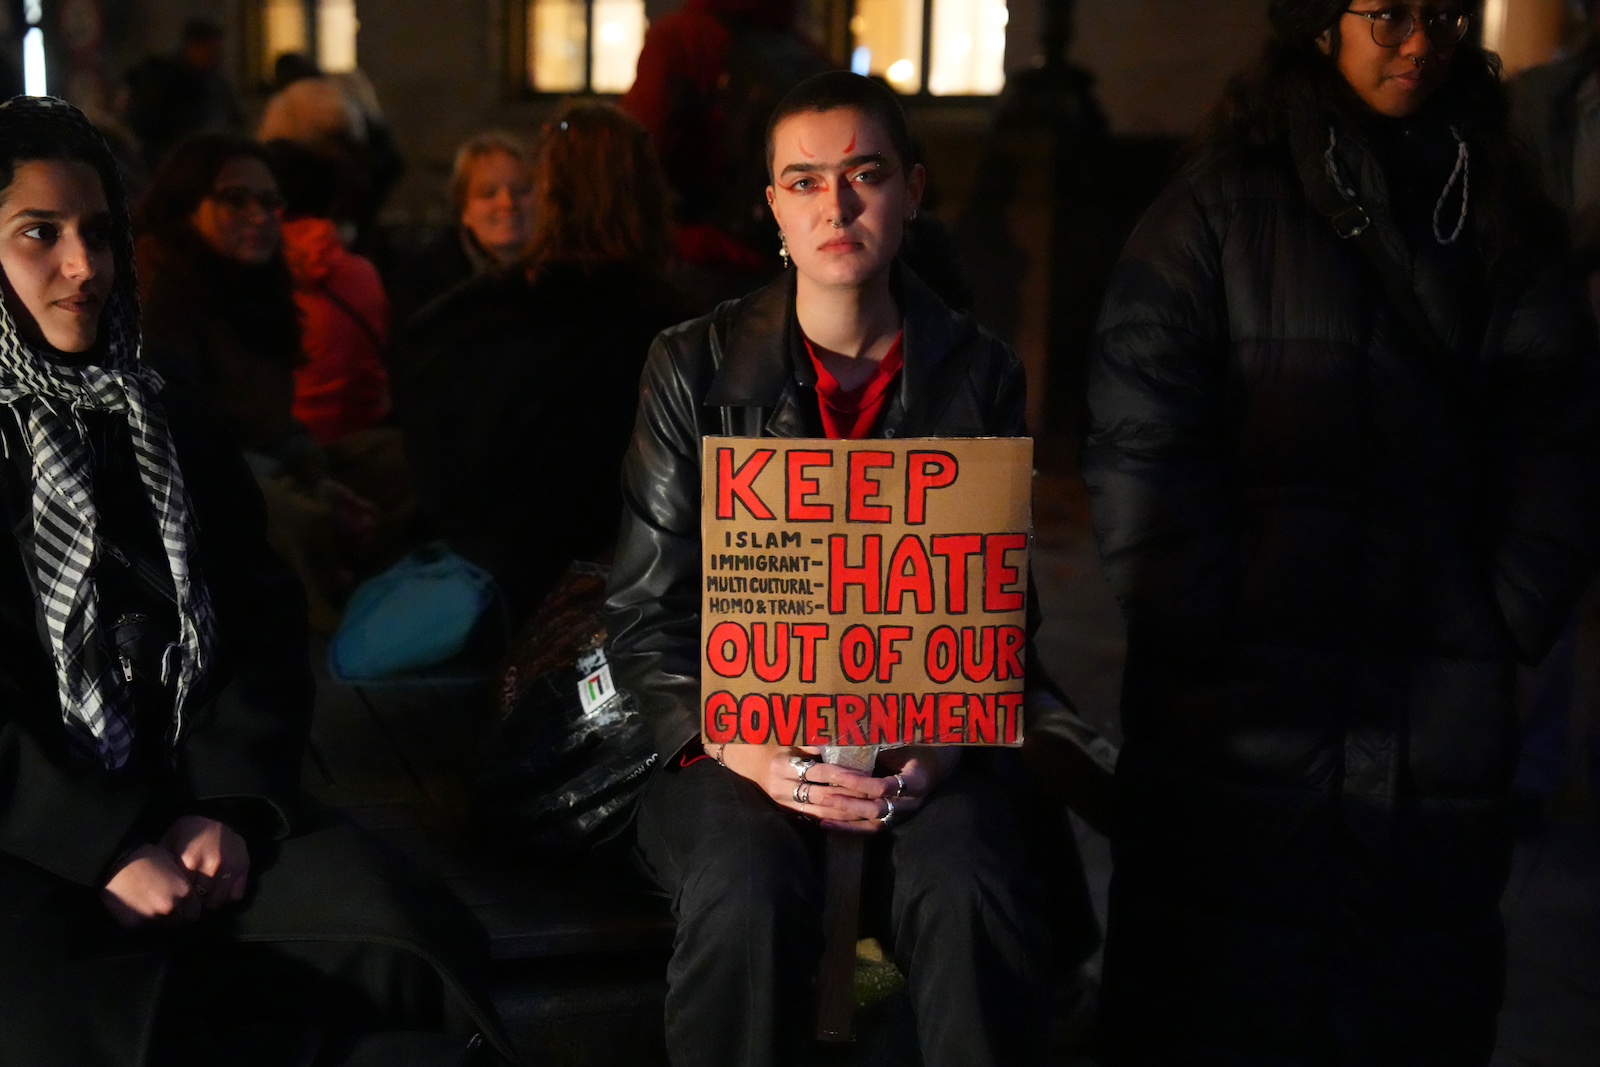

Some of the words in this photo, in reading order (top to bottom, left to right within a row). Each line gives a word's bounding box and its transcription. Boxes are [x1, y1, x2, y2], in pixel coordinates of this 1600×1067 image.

[716, 447, 959, 525] KEEP
[828, 533, 1027, 615] HATE
[706, 621, 829, 683] OUT
[839, 624, 913, 683] OF
[924, 624, 1025, 684] OUR
[704, 690, 1025, 746] GOVERNMENT
